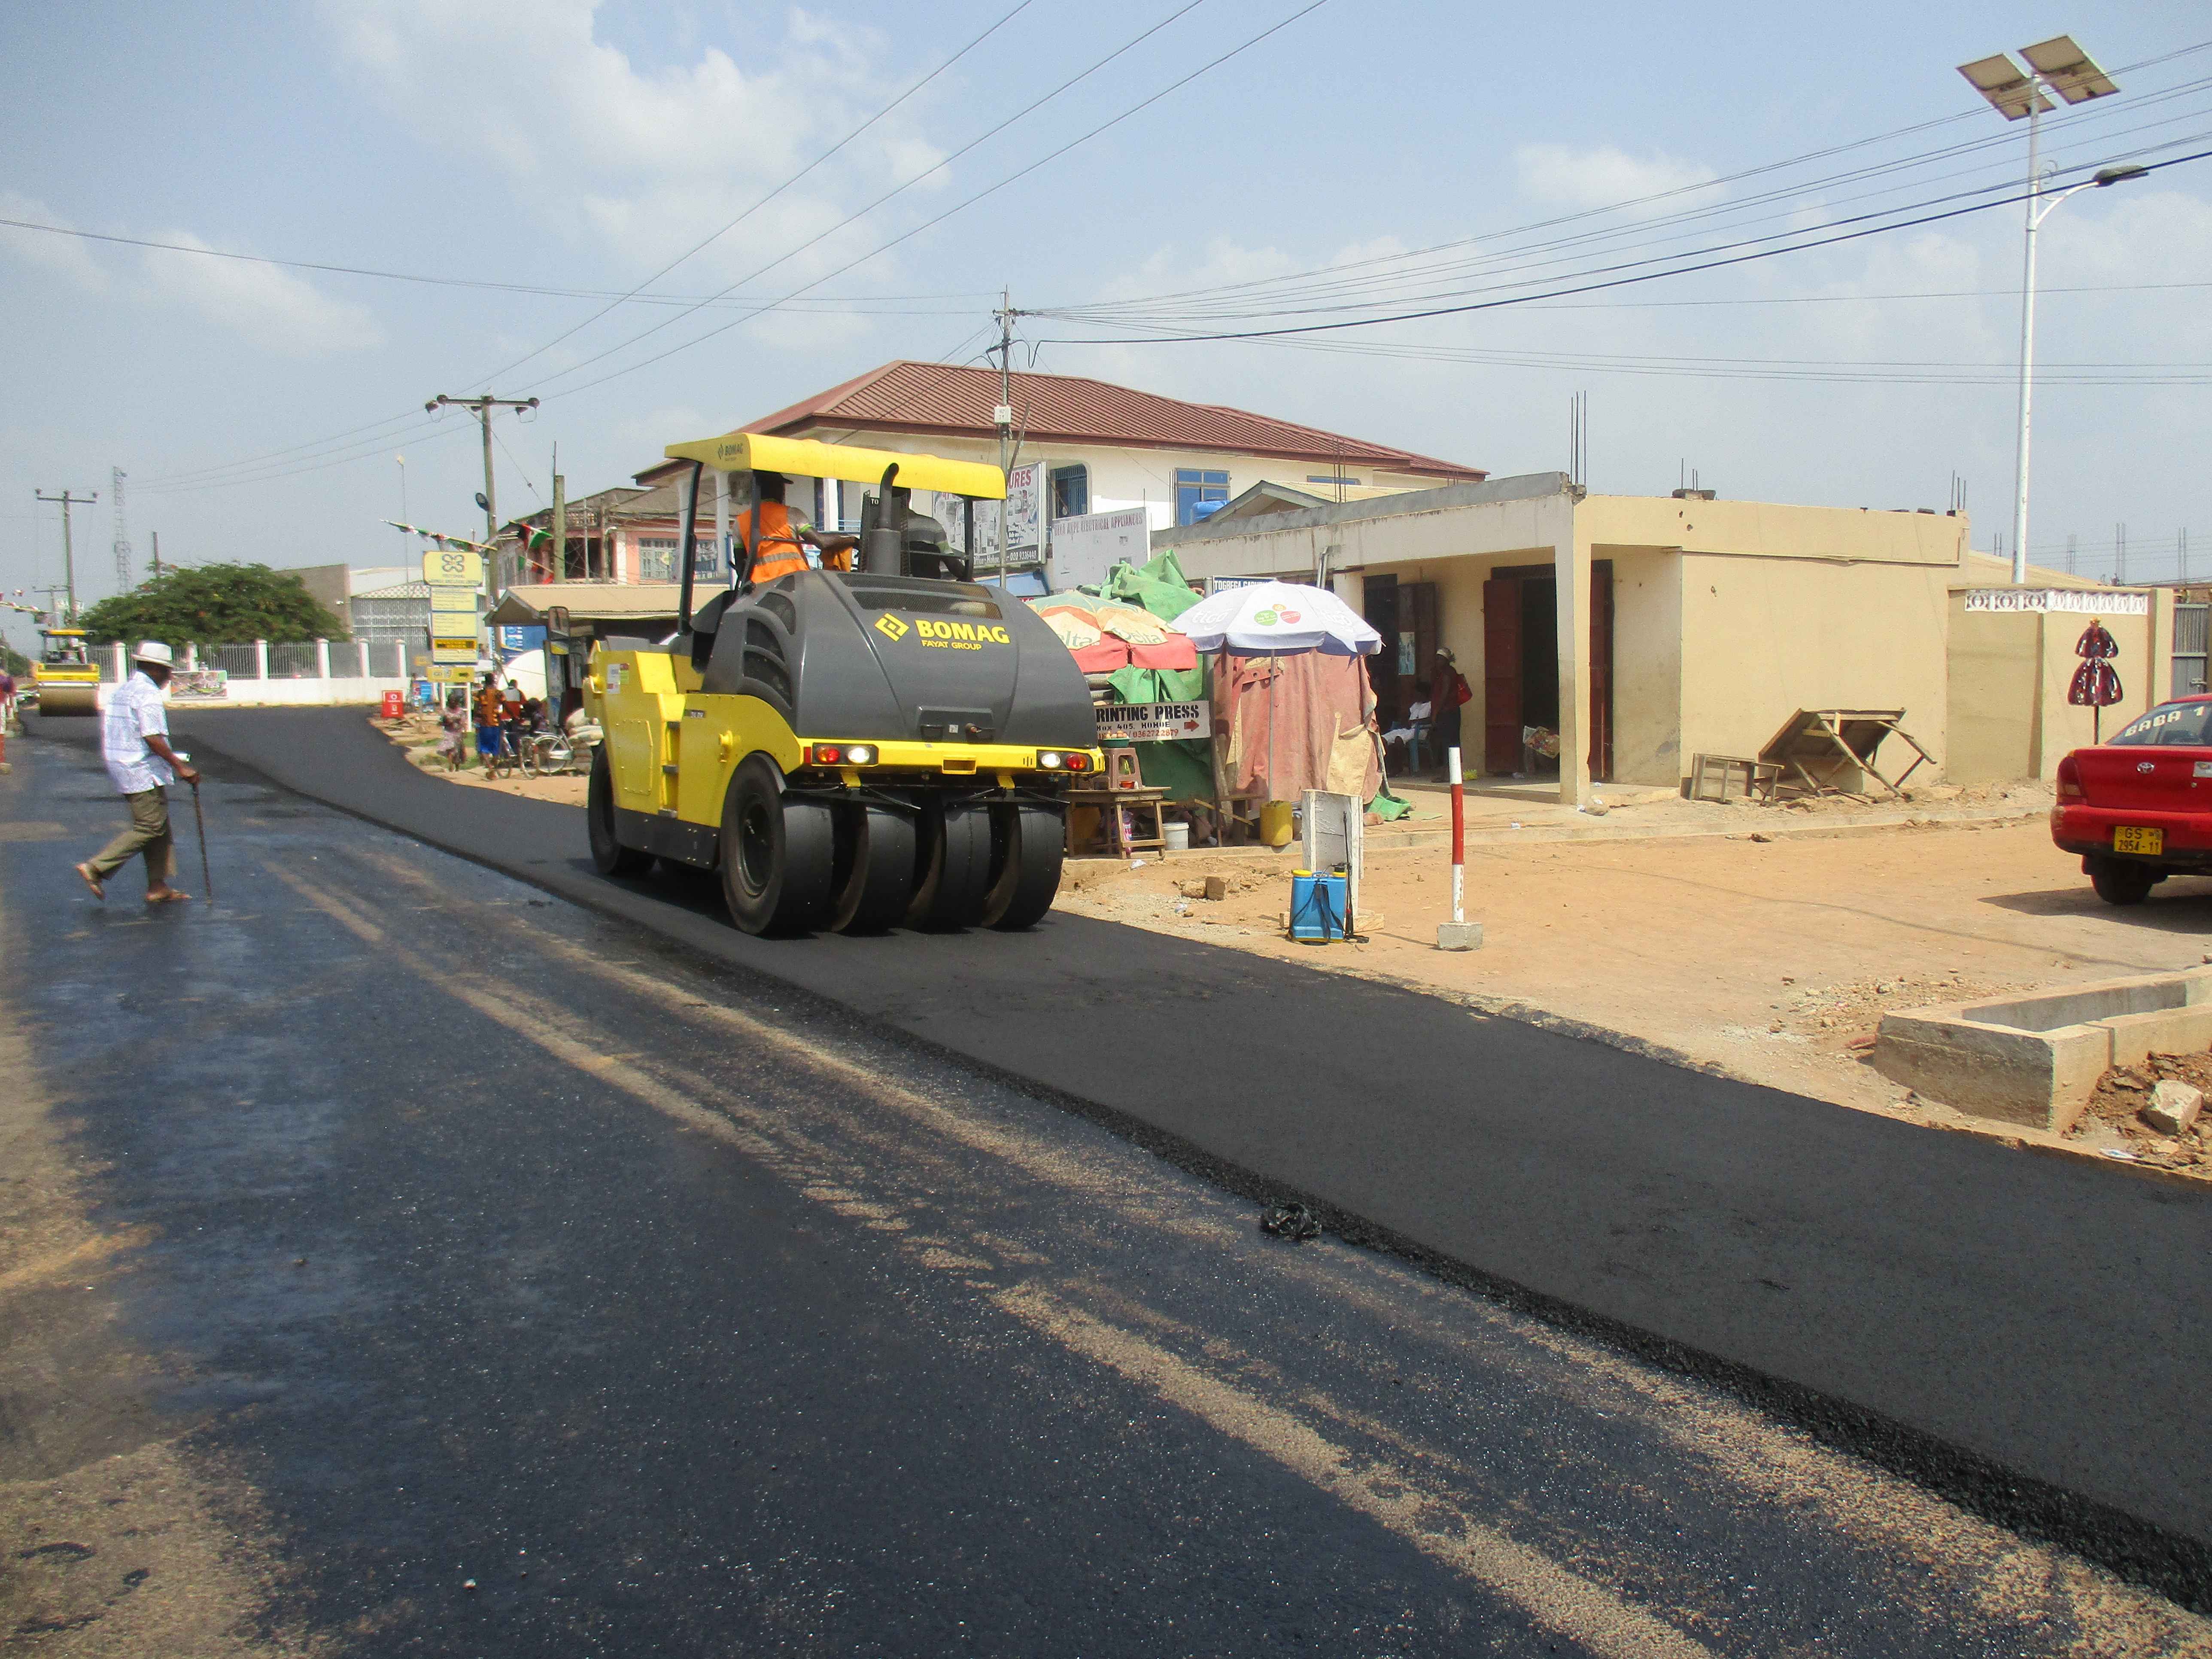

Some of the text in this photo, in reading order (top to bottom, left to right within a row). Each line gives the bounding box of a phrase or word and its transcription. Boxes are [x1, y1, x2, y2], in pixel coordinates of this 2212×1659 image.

[1081, 518, 1109, 532] ELECTRICAL
[1111, 512, 1143, 529] APPLIANCES
[915, 620, 1010, 644] BOMAG
[922, 640, 982, 650] FAYAT GROUP
[1096, 705, 1199, 722] RINTING PRESS
[2125, 711, 2182, 737] BABA
[2125, 828, 2142, 839] GS
